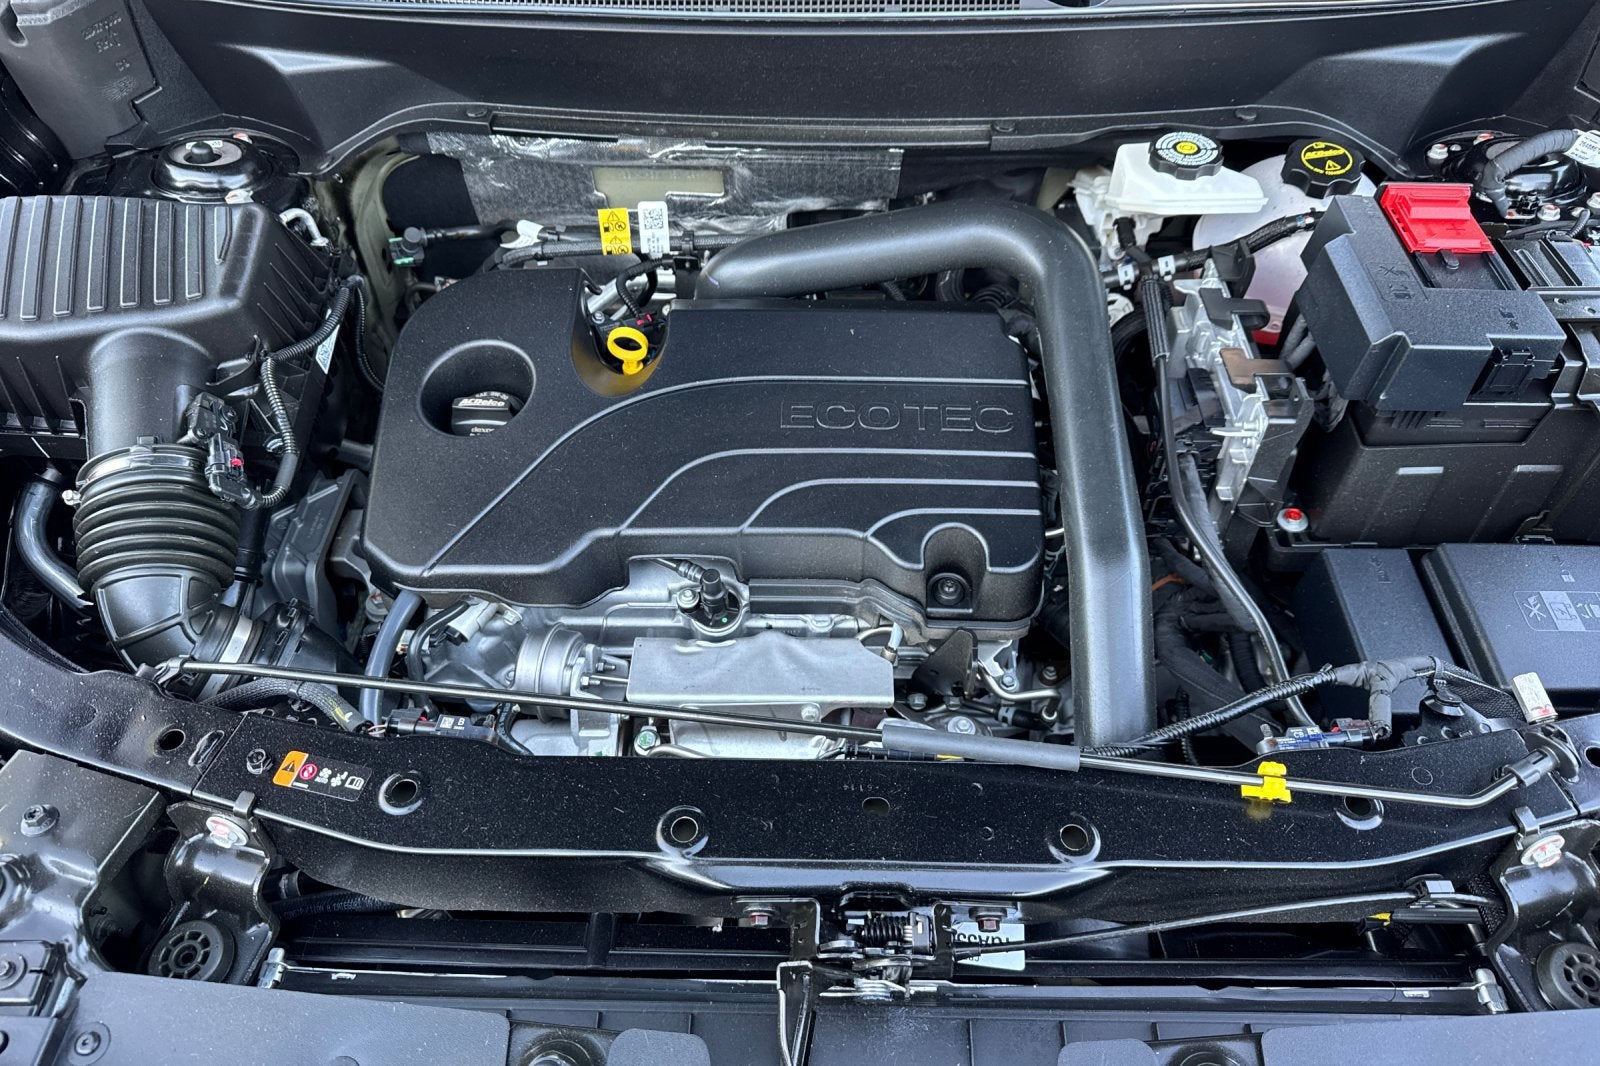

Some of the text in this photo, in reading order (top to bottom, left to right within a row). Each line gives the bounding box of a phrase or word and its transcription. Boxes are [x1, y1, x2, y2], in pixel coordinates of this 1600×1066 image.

[458, 398, 506, 407] ACDelco
[780, 401, 1014, 433] ECOTEC
[457, 717, 466, 726] B
